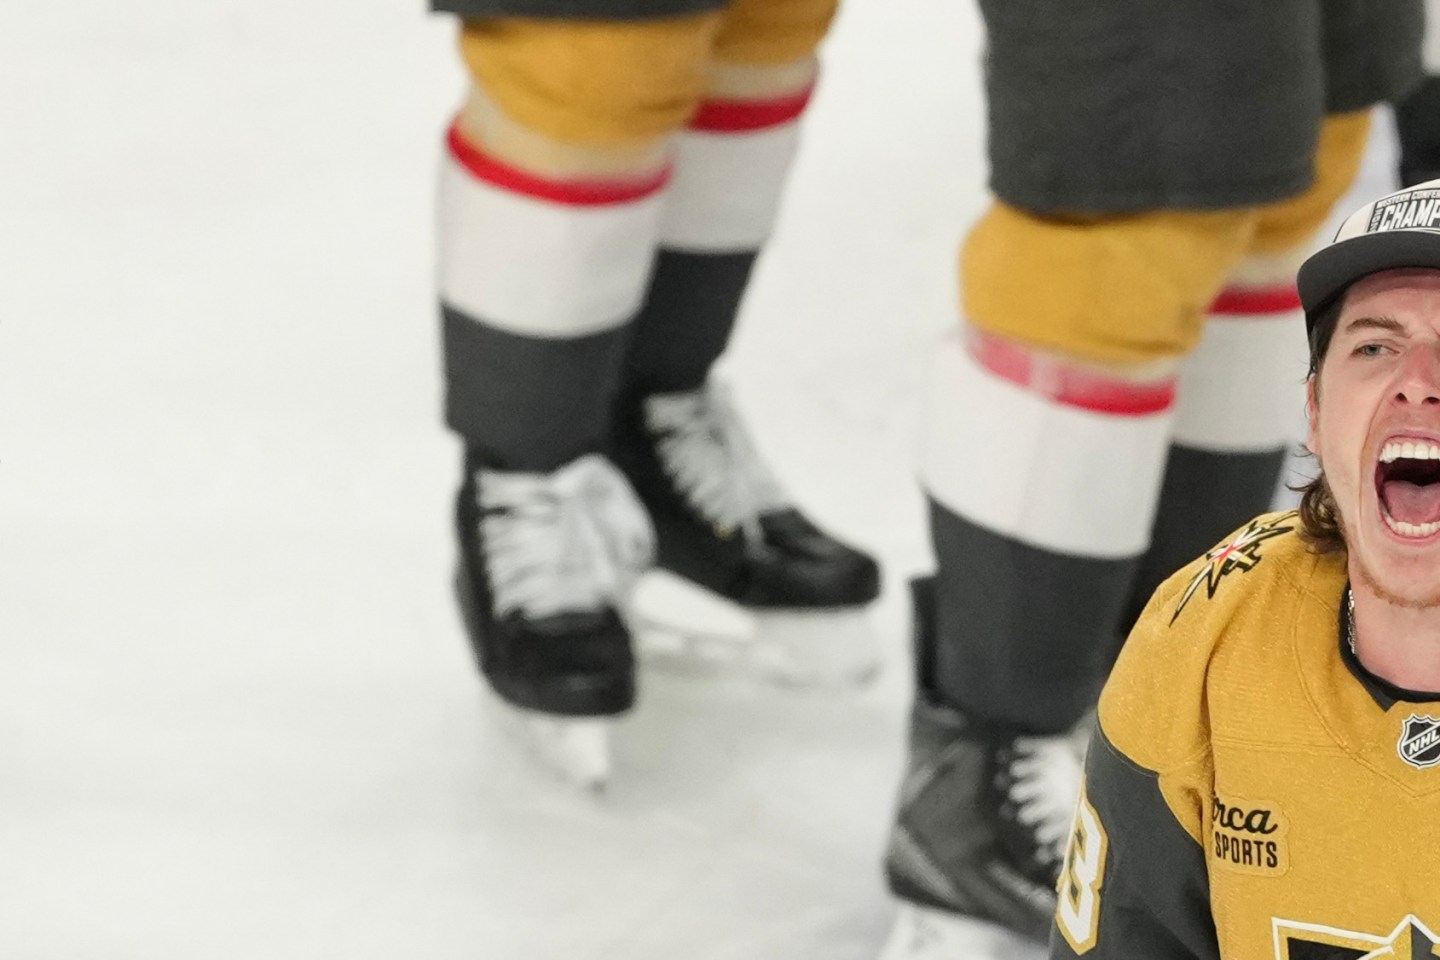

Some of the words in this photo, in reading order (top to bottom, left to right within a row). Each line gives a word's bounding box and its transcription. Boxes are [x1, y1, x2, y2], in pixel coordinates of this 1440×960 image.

[1409, 729, 1440, 755] NHL
[1212, 797, 1278, 835] rca
[1214, 831, 1278, 868] SPORTS
